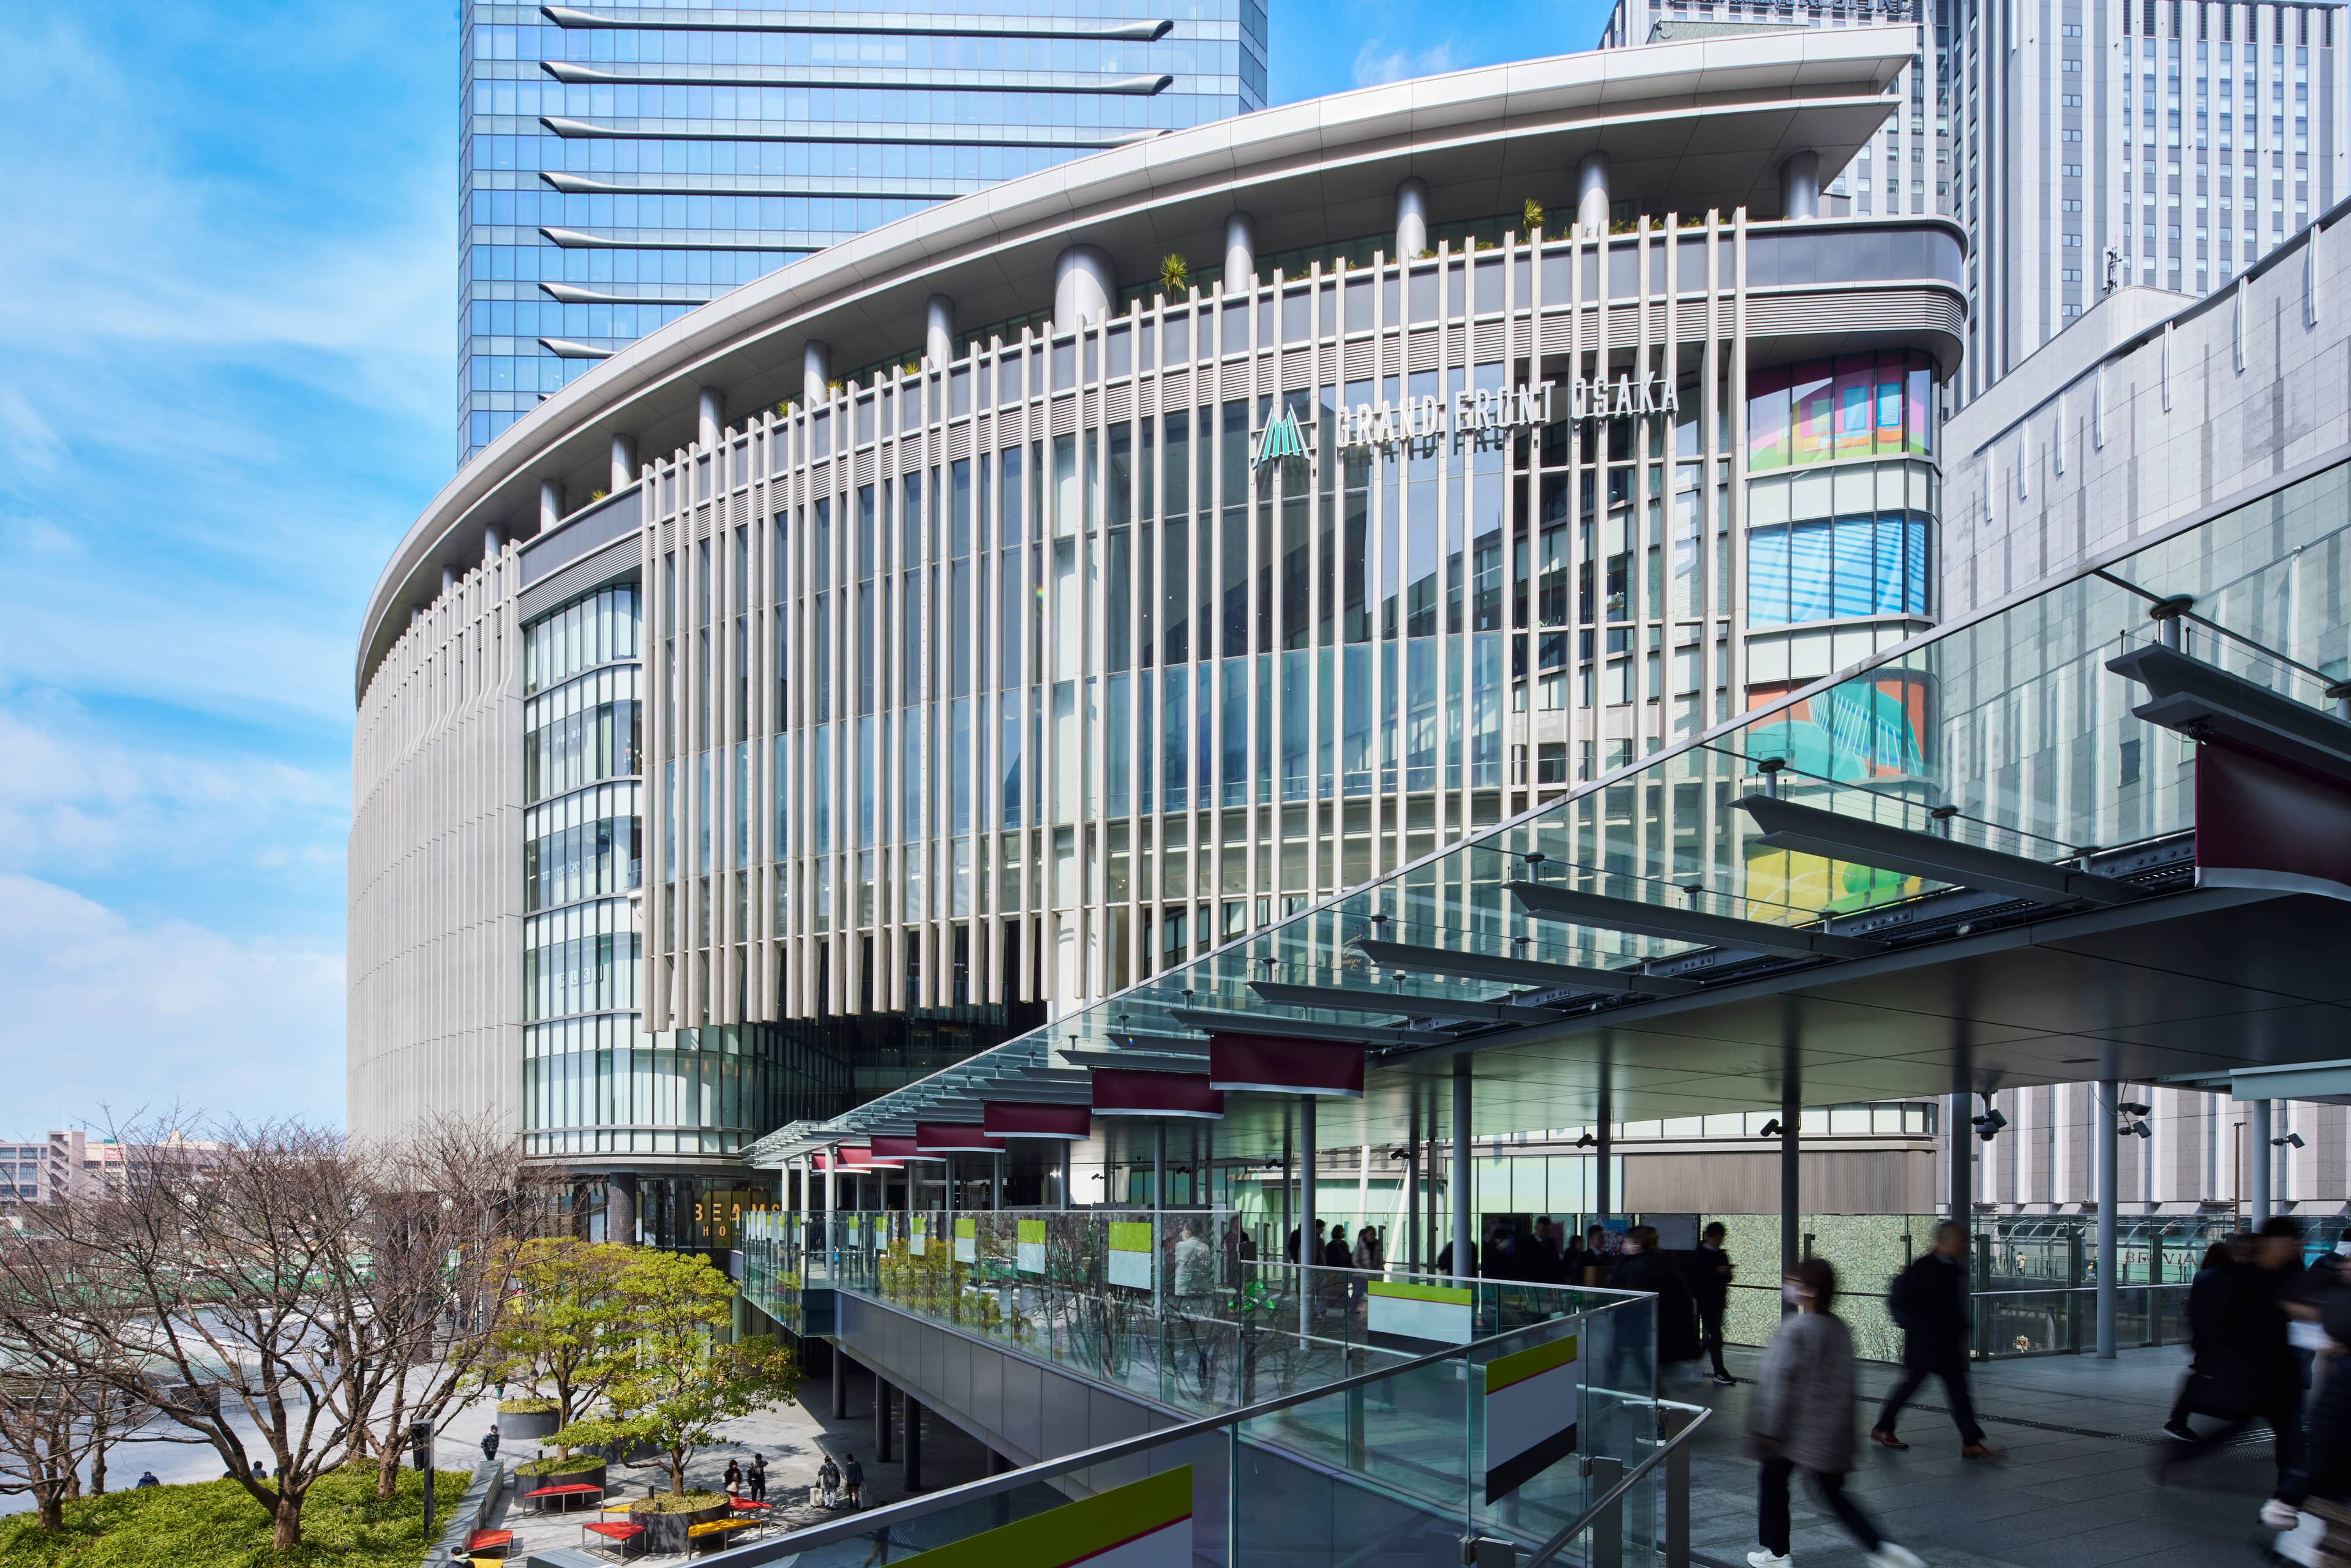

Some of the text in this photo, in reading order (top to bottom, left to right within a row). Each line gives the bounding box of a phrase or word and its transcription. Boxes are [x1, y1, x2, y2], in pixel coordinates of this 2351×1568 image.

[1336, 370, 1679, 448] GRAND FRONT OSAKA
[2126, 1251, 2196, 1266] BRVIA
